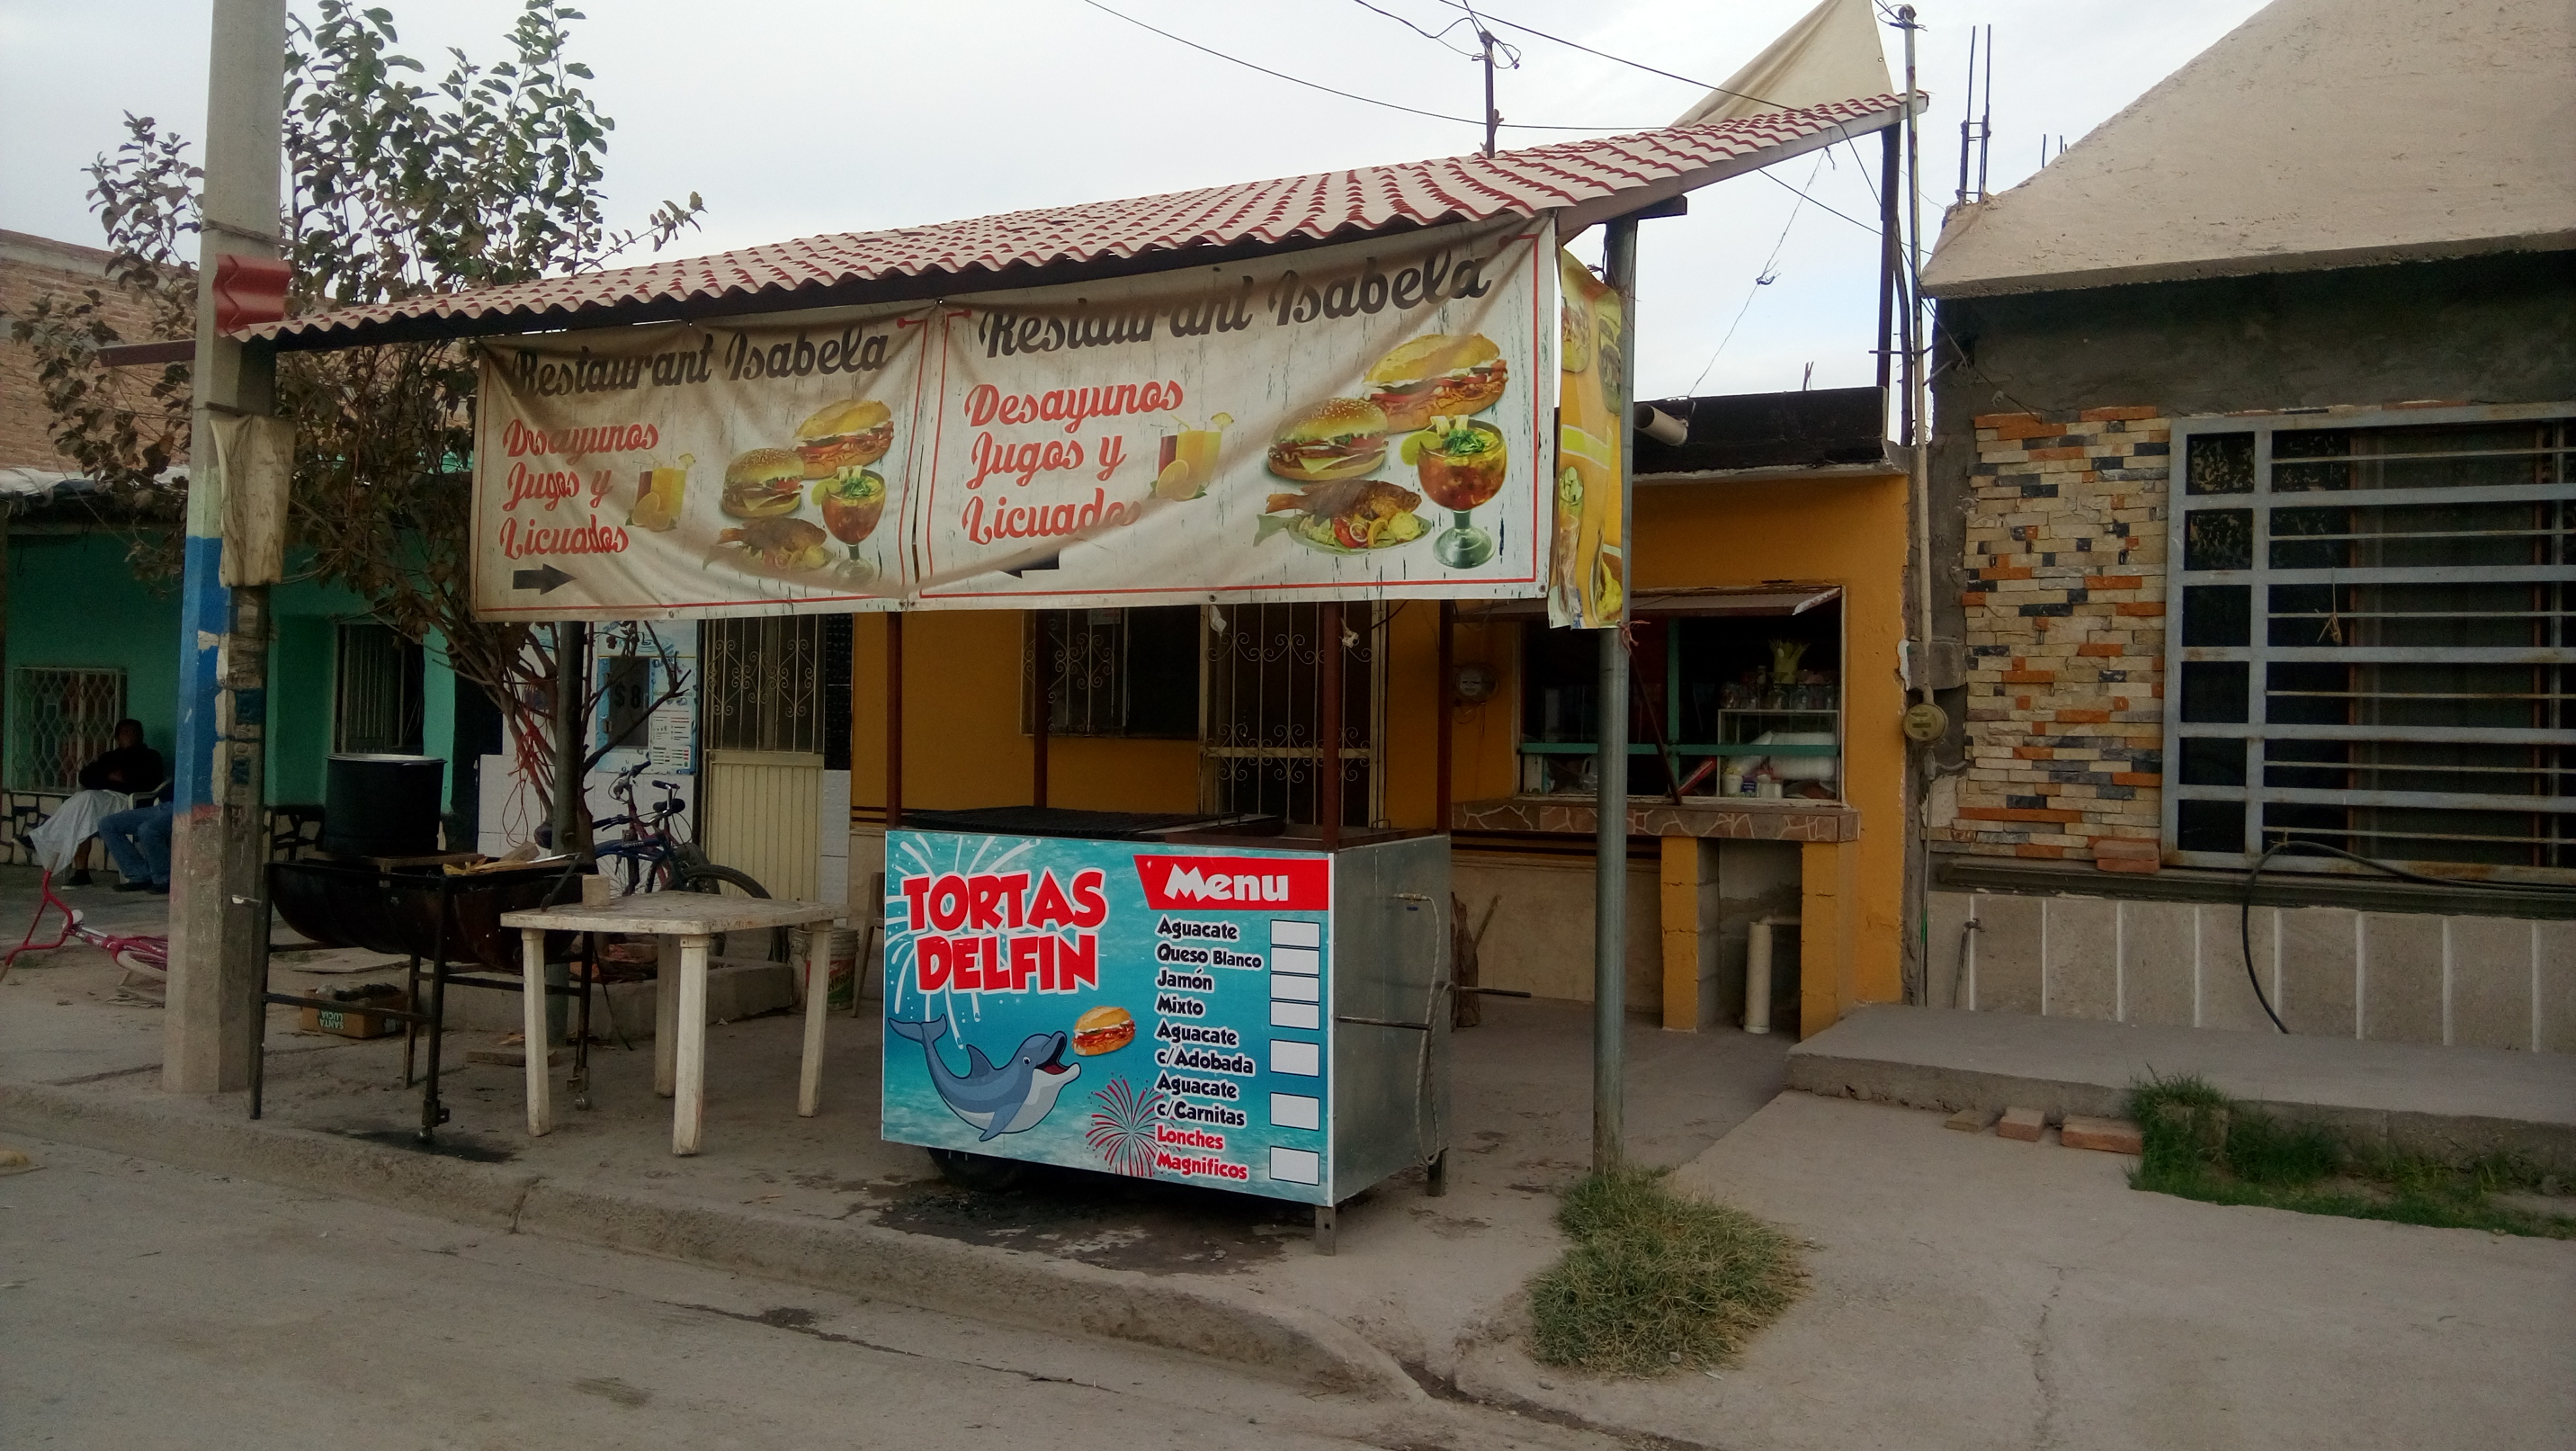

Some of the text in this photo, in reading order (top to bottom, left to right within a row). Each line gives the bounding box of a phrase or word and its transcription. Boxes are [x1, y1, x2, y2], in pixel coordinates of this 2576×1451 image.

[978, 250, 1492, 358] Restaurant Isabela
[511, 327, 891, 396] Restaurant Isabela
[964, 380, 1184, 433] Desayunos
[966, 431, 1127, 490] Jugos y
[503, 461, 614, 511] Jugos y
[962, 488, 1141, 545] Licuados
[499, 514, 629, 559] Licuados
[1163, 864, 1288, 902] Menu
[902, 868, 1108, 933] TORTAS
[1157, 917, 1237, 940] Aguacate
[916, 934, 1097, 991] DELFIN
[1157, 943, 1262, 969] Queso Blanco
[1157, 968, 1212, 990] Jamón
[321, 1010, 343, 1022] LUCIA
[1157, 994, 1204, 1016] Mixto
[319, 1018, 344, 1030] SANTA
[1157, 1021, 1237, 1045] Aguacate
[1157, 1048, 1253, 1074] c/Adobada
[1157, 1072, 1237, 1098] Aguacate
[1157, 1100, 1245, 1126] c/Carnitas
[1157, 1125, 1224, 1149] Lonches
